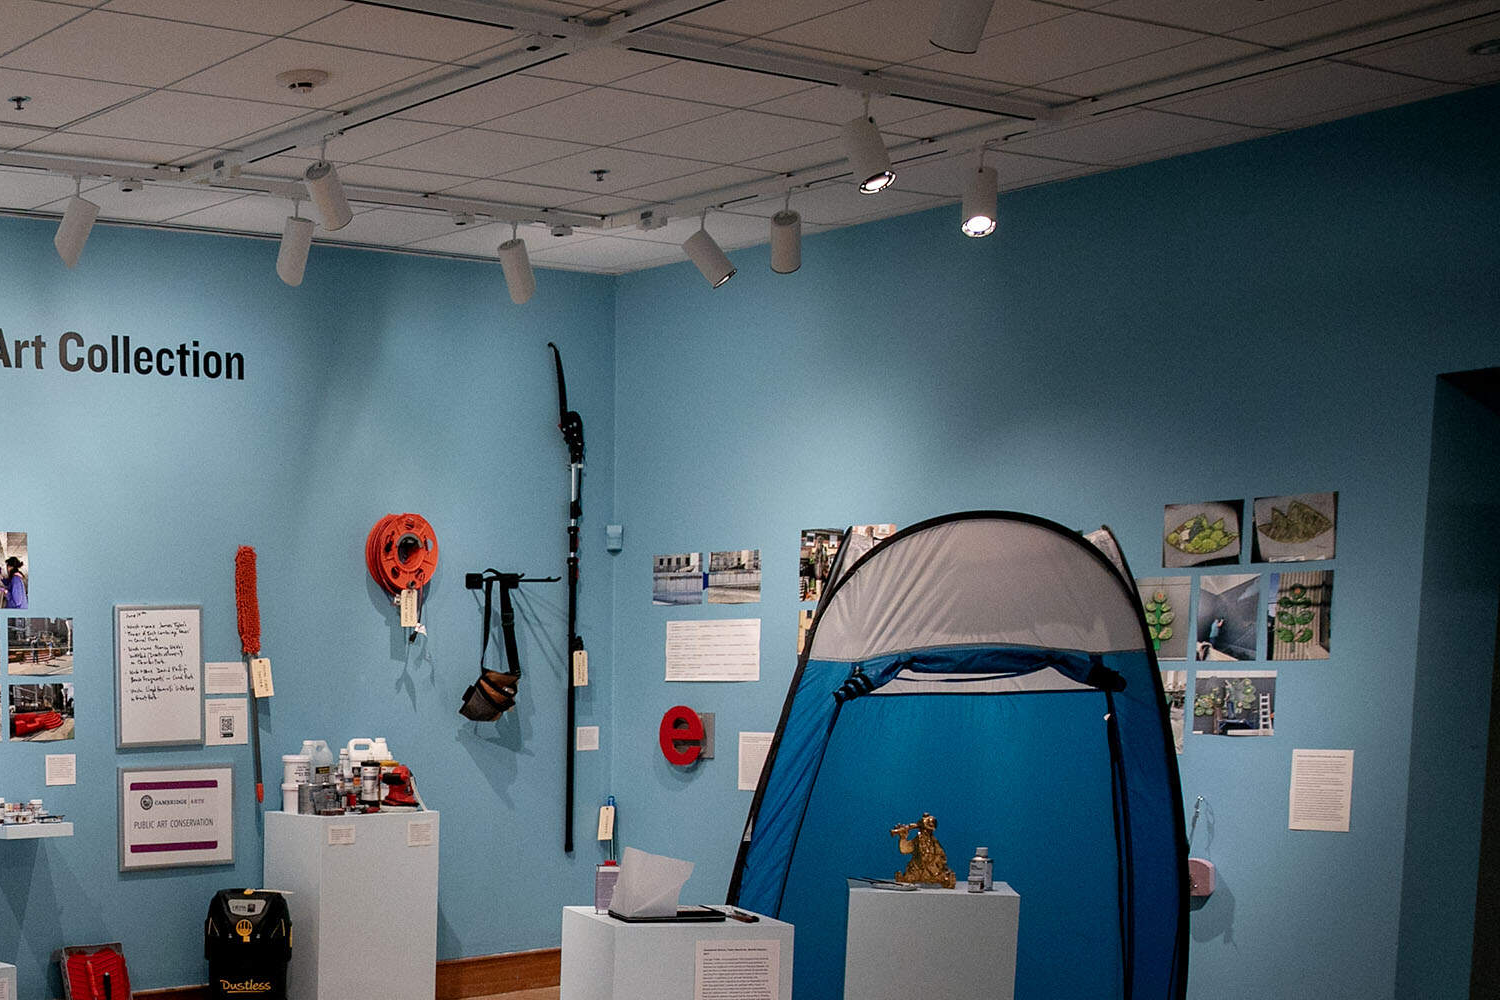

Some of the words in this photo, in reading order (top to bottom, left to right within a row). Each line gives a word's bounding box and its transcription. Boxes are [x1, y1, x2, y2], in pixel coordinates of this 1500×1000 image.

[59, 331, 245, 380] Collection
[659, 705, 705, 767] e
[133, 820, 155, 830] PUBLIC
[156, 819, 168, 829] ART
[170, 817, 214, 829] CONSERVATION
[219, 979, 272, 991] Dustless
